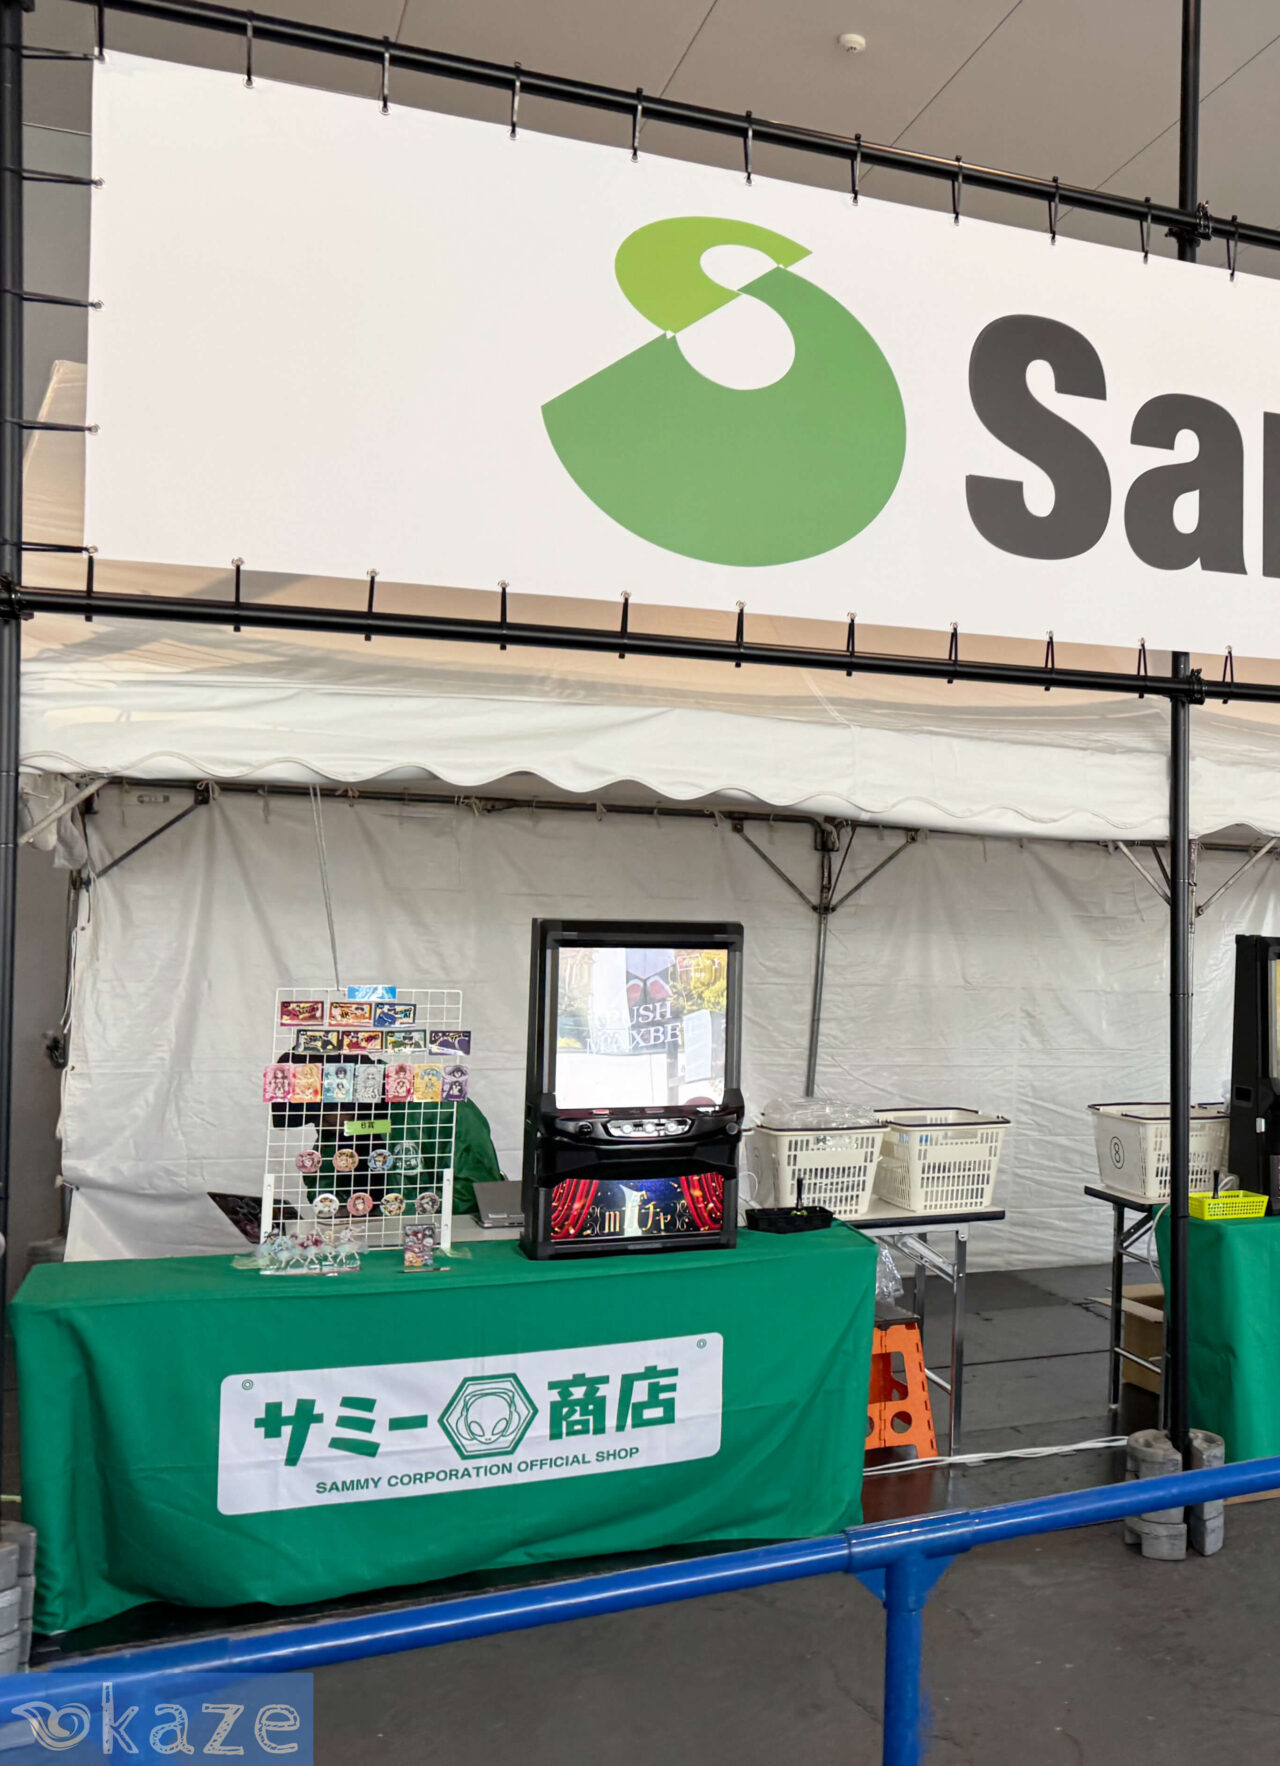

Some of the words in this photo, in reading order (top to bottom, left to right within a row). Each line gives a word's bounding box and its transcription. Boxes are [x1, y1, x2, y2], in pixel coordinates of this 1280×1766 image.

[254, 1397, 428, 1467] サミー
[547, 1365, 679, 1441] 商店
[315, 1475, 383, 1494] SAMMY
[386, 1462, 513, 1488] CORPORATION
[517, 1453, 592, 1473] OFFICIAL
[595, 1446, 641, 1462] SHOP
